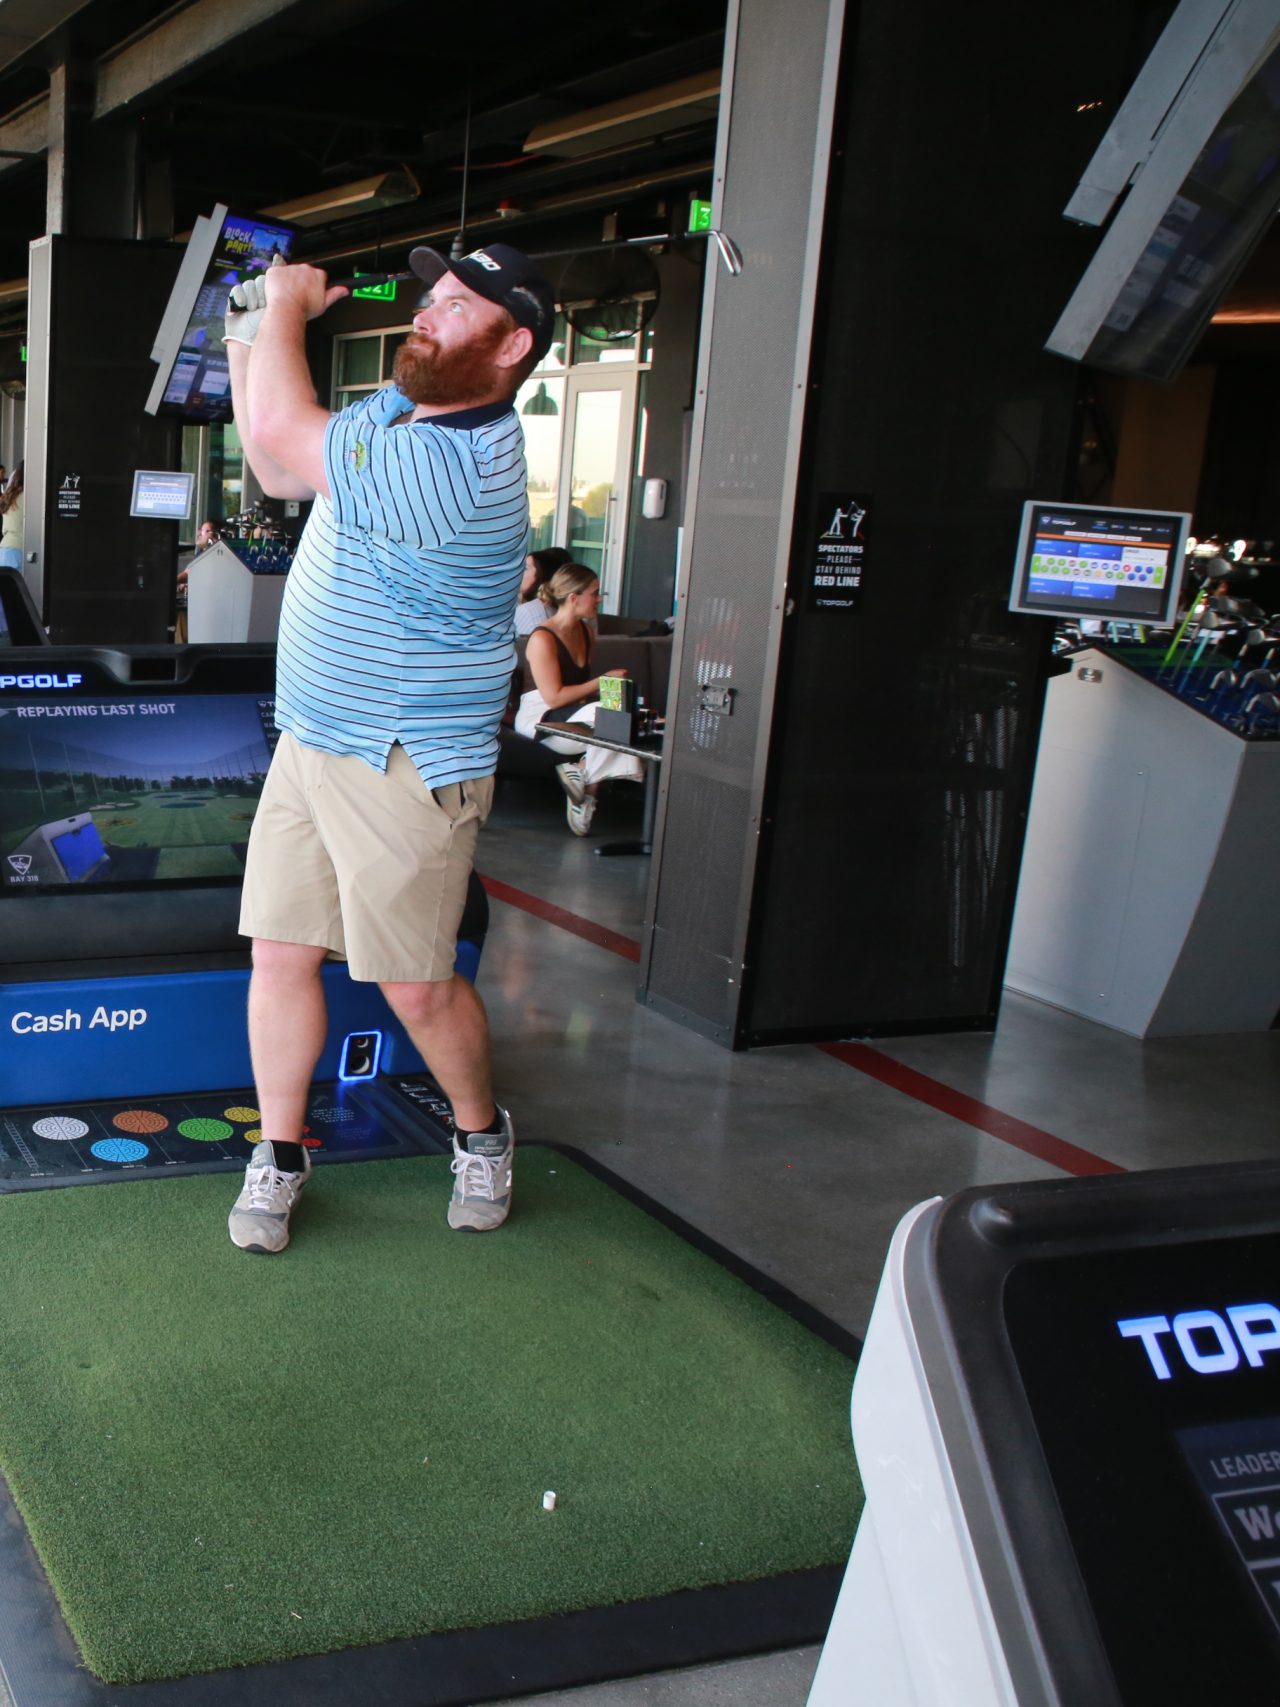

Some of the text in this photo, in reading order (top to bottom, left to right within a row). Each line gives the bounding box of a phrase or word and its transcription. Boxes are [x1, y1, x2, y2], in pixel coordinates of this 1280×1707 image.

[818, 544, 864, 553] SPECTATORS
[826, 555, 853, 563] PLEASE
[835, 566, 861, 574] BEHIND
[814, 576, 860, 587] RED LINE
[17, 703, 176, 718] REPLAYING LAST SHOT
[11, 1009, 81, 1034] Cash
[89, 1006, 147, 1031] App
[1117, 1303, 1280, 1380] TOP
